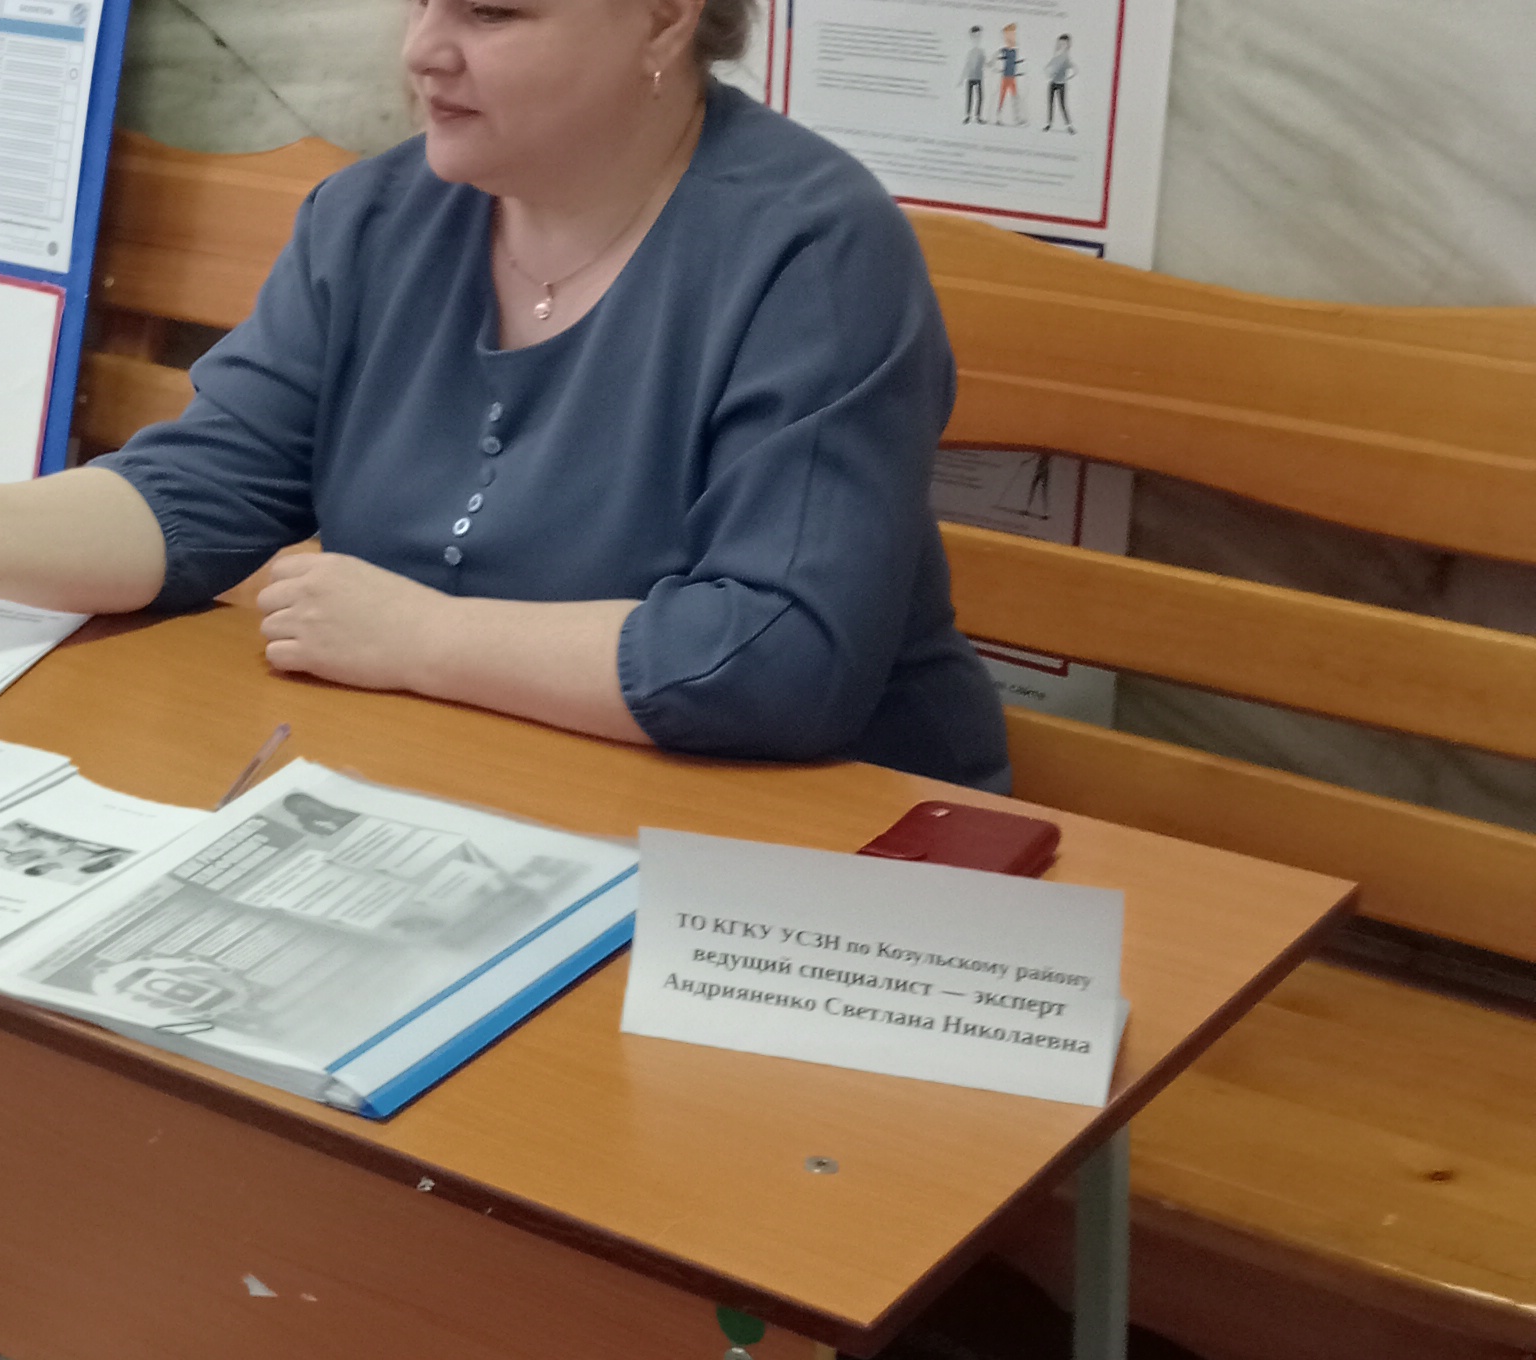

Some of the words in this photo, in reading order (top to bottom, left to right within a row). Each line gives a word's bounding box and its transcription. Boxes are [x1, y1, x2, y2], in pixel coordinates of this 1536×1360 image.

[677, 912, 706, 931] ТО
[712, 917, 774, 939] КГКУ
[781, 926, 843, 952] УСЗН
[845, 940, 871, 956] по
[876, 942, 1010, 980] Козульскому
[1015, 965, 1092, 991] району
[692, 947, 793, 975] ведущий
[798, 963, 933, 997] специалист
[974, 990, 1069, 1019] эксперт
[663, 972, 817, 1012] Андрияненко
[823, 996, 934, 1031] Светлана
[941, 1015, 1092, 1055] Николаевна
